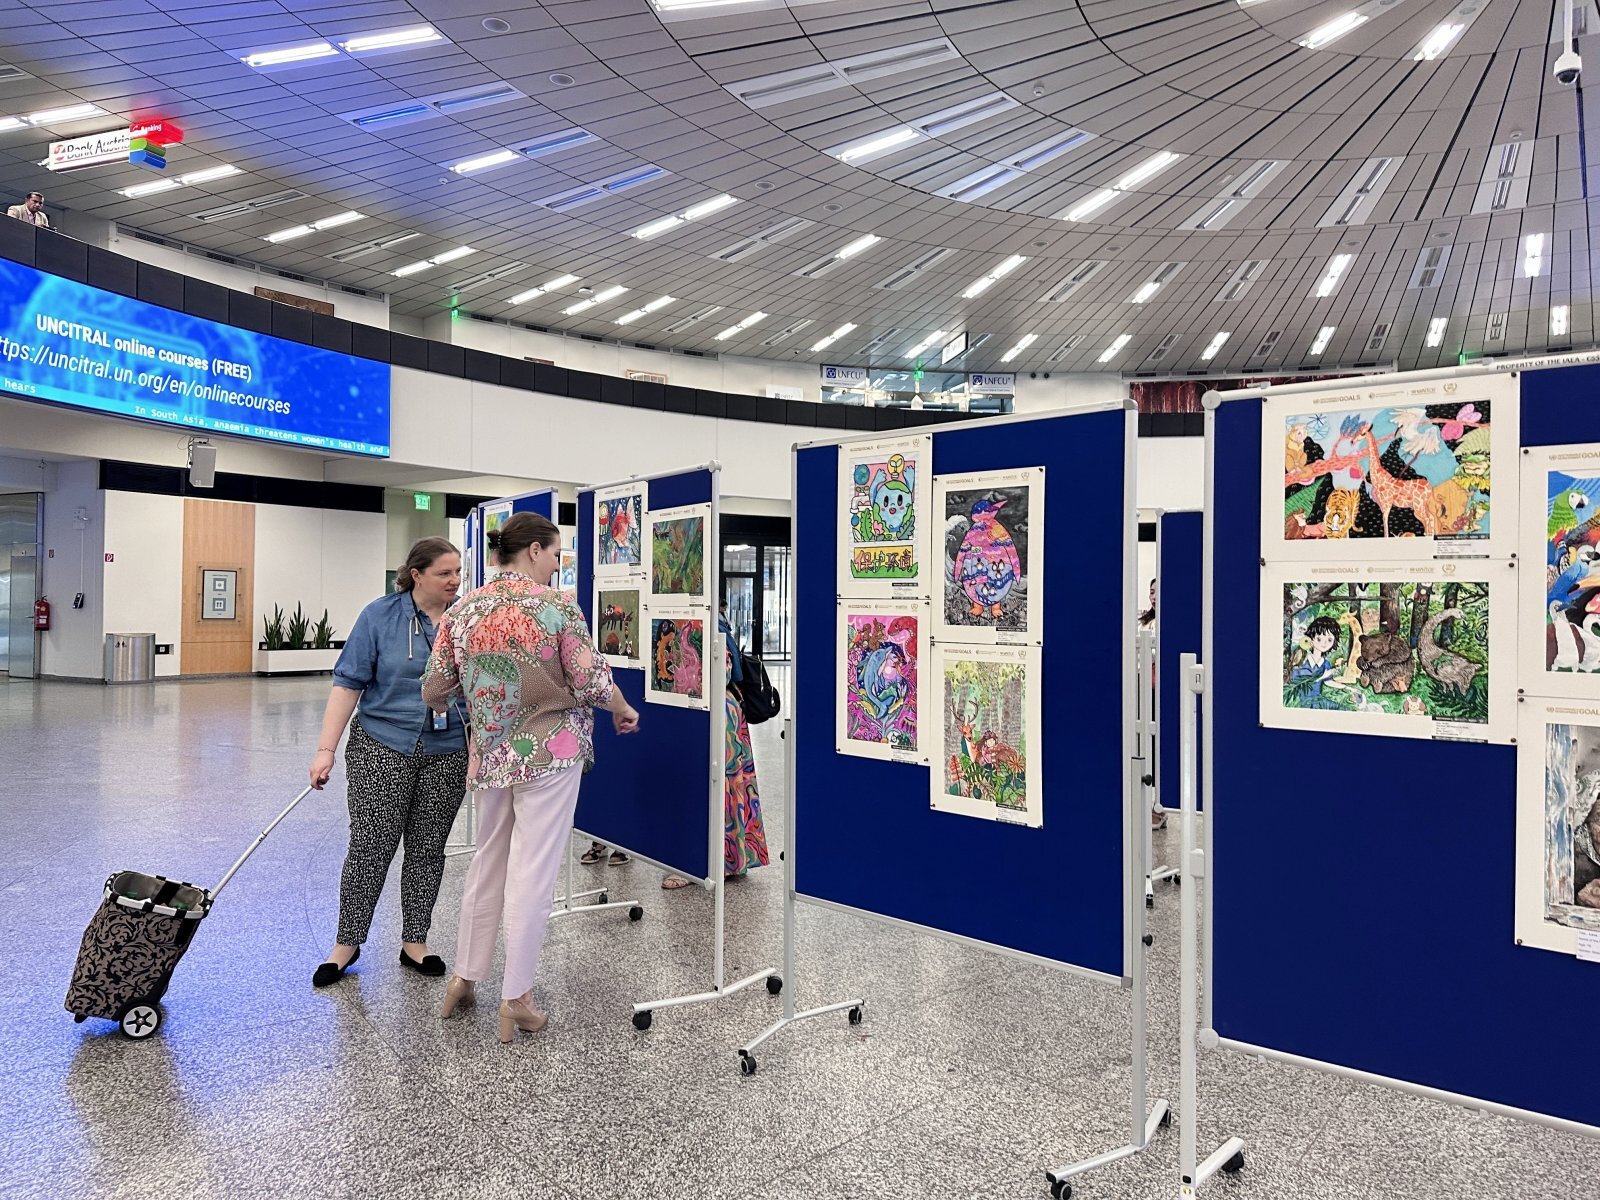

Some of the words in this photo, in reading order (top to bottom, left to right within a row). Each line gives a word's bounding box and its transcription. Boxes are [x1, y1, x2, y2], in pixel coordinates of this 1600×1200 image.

[67, 141, 93, 158] Bank
[36, 313, 111, 348] UNCITRAL
[114, 337, 155, 358] online
[158, 348, 209, 371] courses
[212, 358, 252, 383] (FREE)
[1496, 361, 1533, 370] PROPERTY
[4, 378, 36, 393] hears
[134, 405, 146, 415] In
[151, 408, 178, 421] South
[182, 415, 209, 428] Asia,
[214, 421, 250, 433] anaemia
[254, 426, 298, 441] threatens
[301, 434, 334, 447] women's
[339, 440, 365, 452] health
[369, 445, 384, 454] and
